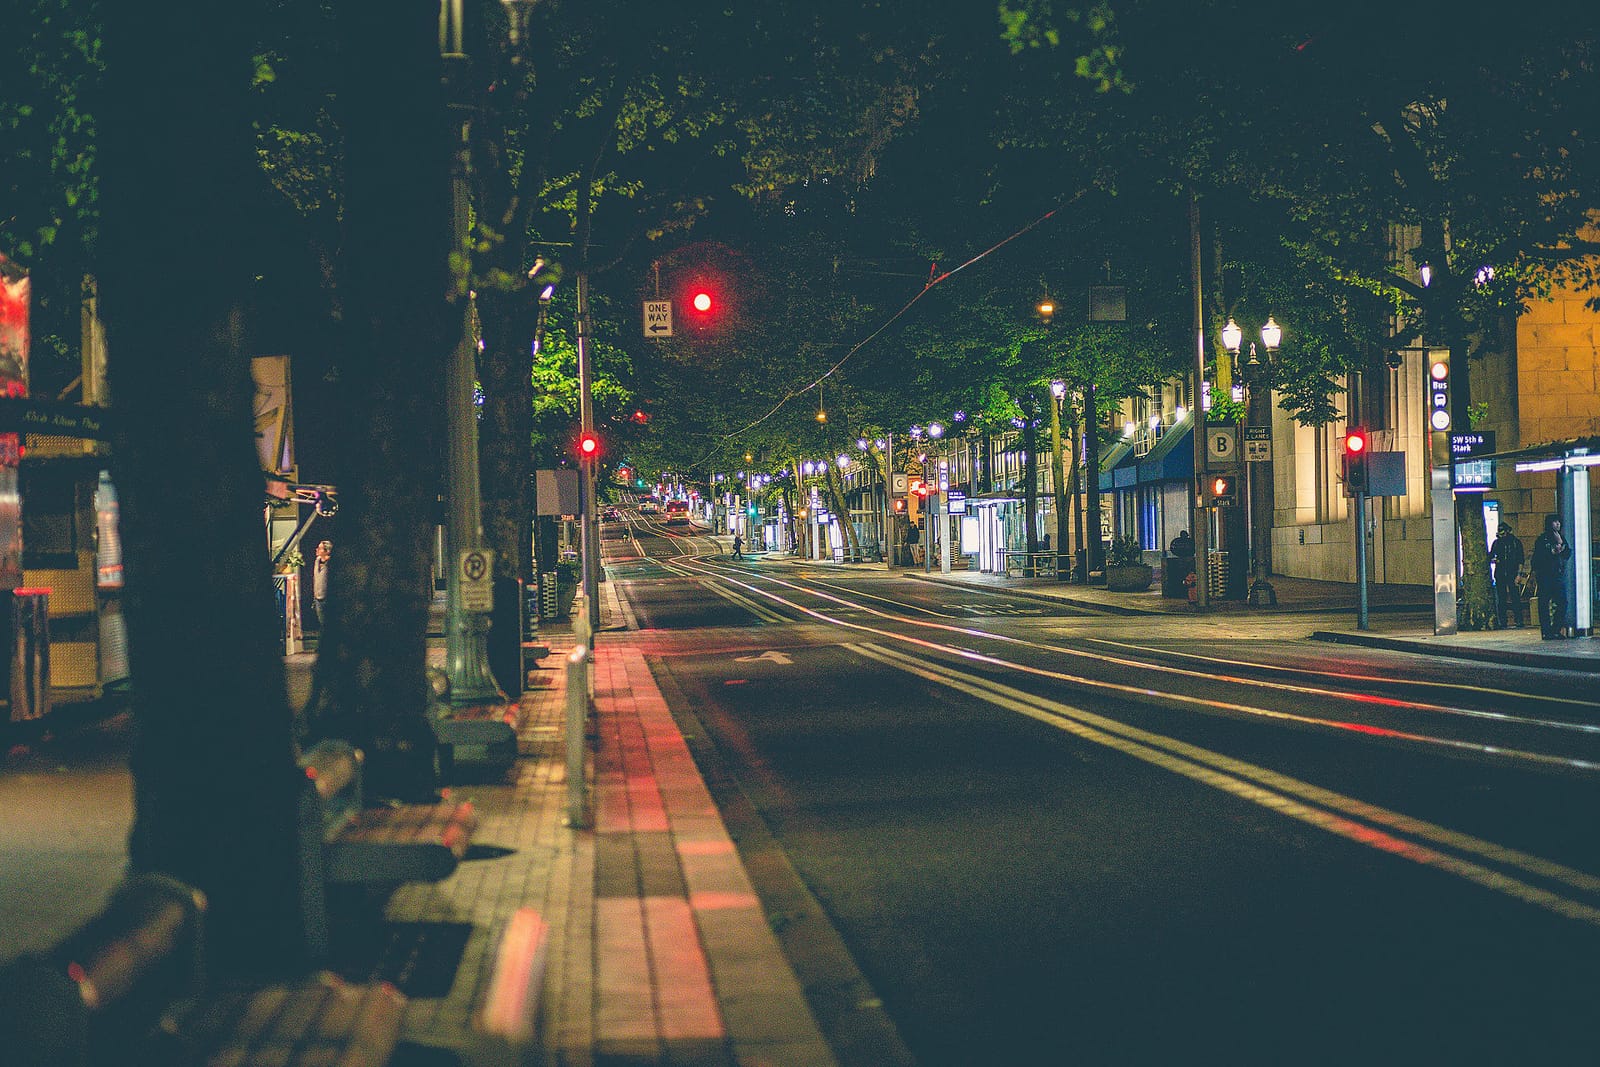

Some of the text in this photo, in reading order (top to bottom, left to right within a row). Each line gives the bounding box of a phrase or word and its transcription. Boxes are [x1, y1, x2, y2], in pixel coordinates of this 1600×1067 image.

[648, 303, 668, 313] ONE
[648, 313, 668, 322] WAY
[1432, 381, 1448, 389] Bus
[1452, 436, 1463, 444] SW
[1464, 435, 1477, 444] 5th
[1216, 436, 1228, 453] B
[1452, 444, 1472, 452] Stark
[896, 479, 903, 488] C
